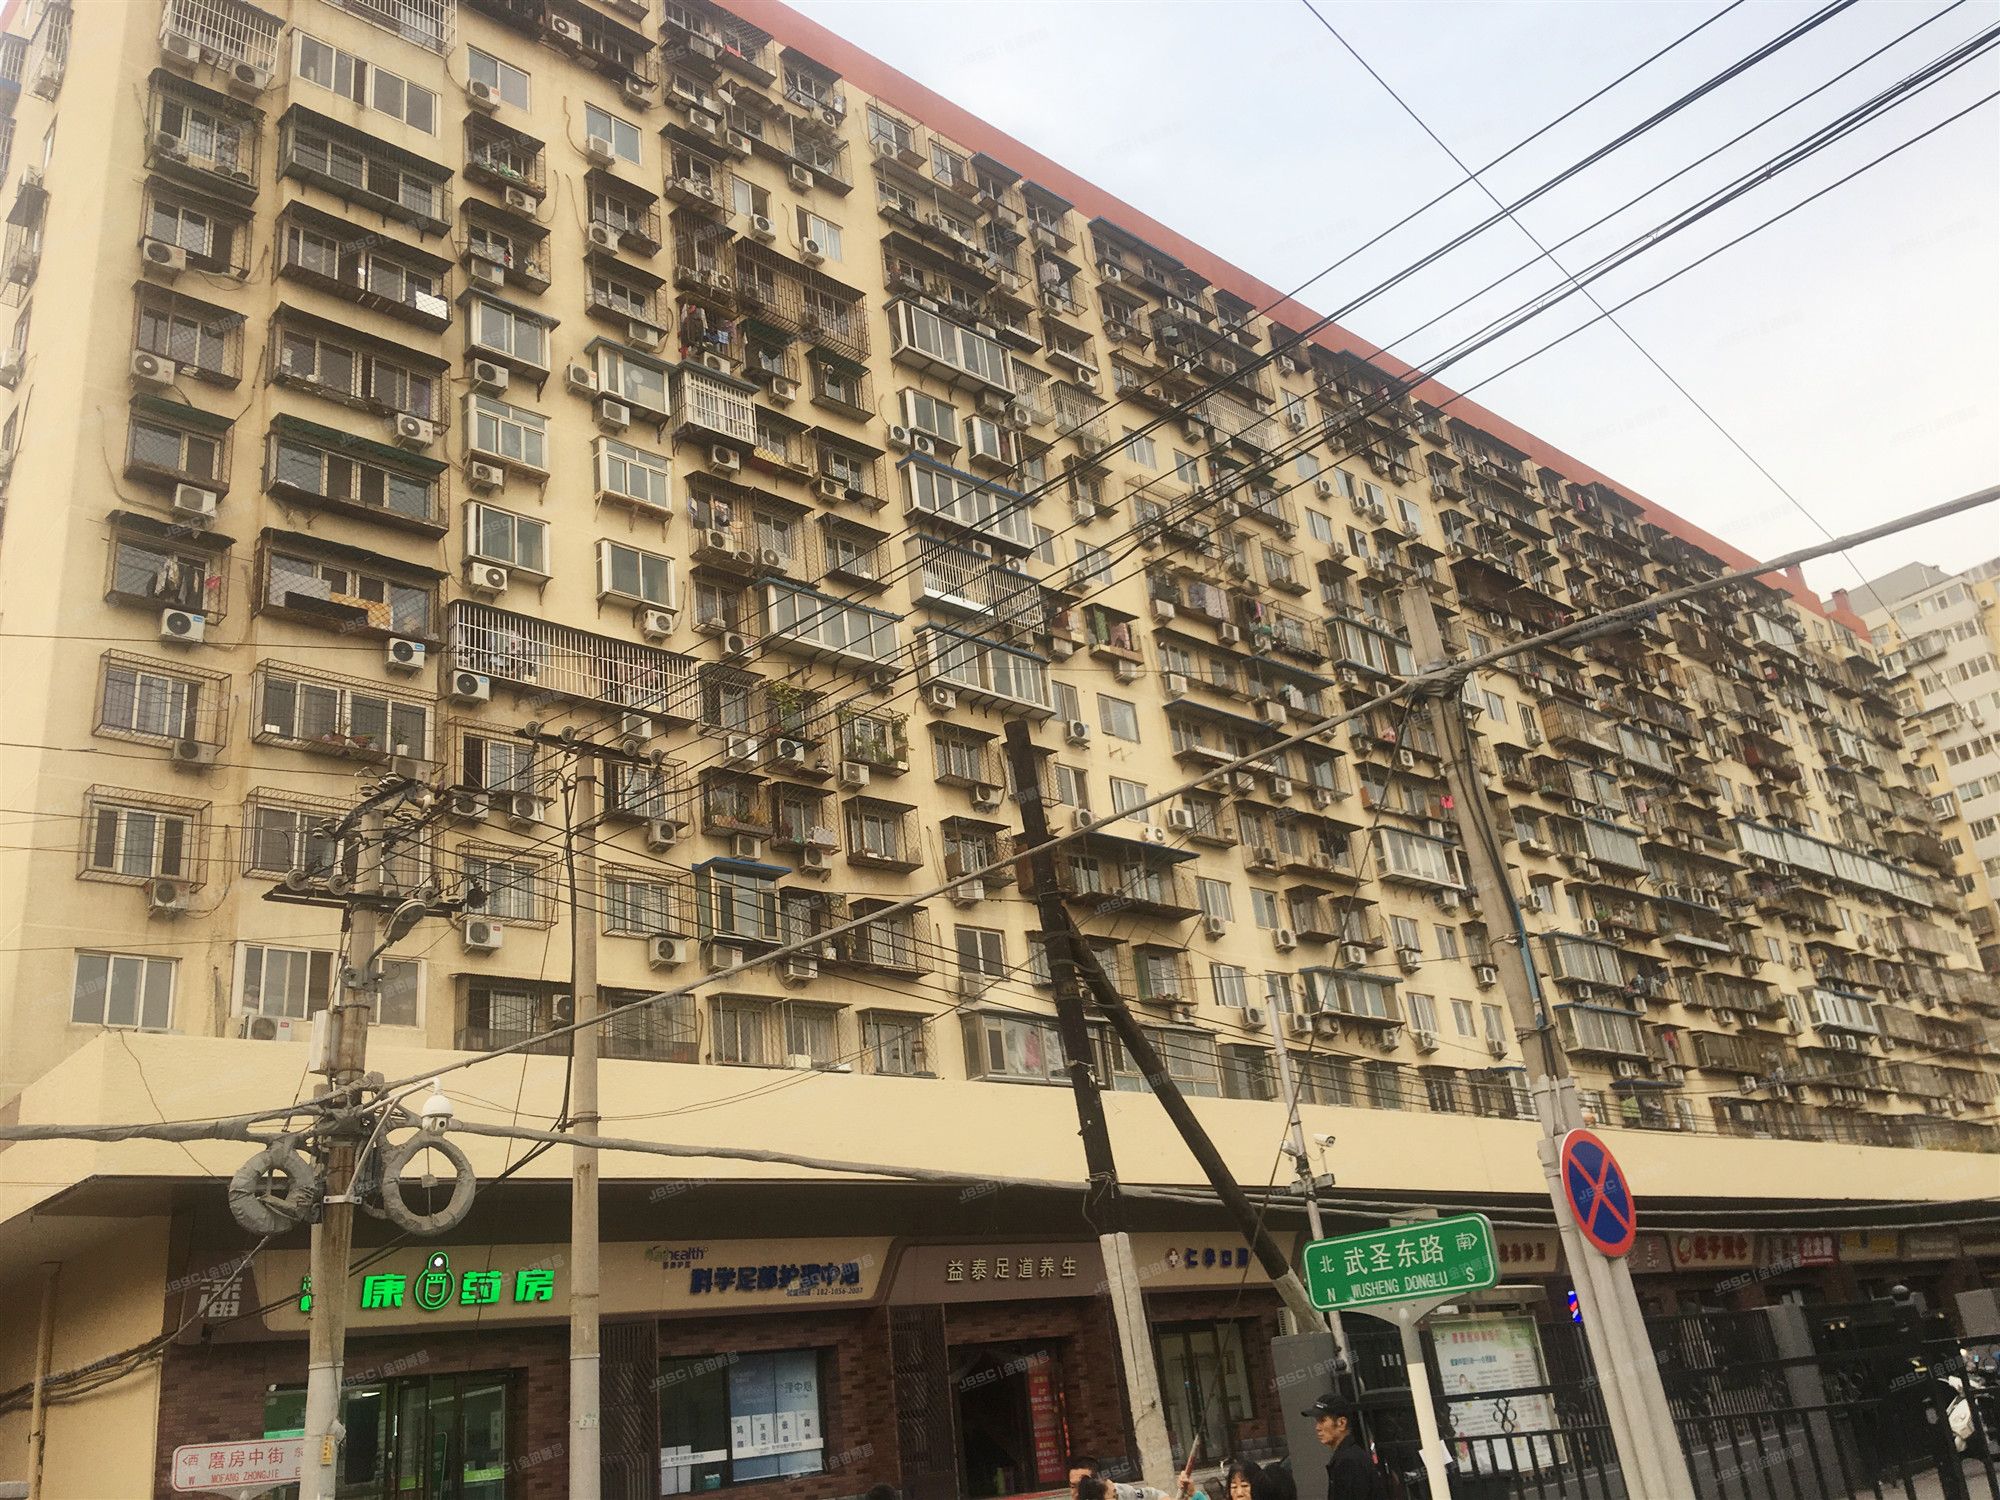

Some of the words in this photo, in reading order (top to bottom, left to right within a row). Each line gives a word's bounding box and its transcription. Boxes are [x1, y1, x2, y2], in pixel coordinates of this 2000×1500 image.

[1320, 1255, 1334, 1274] 北
[1344, 1234, 1444, 1276] 武圣东路
[1456, 1232, 1472, 1252] 南
[946, 1256, 1078, 1282] 益泰足道养生
[1328, 1288, 1336, 1302] N
[1351, 1279, 1399, 1299] WUSHENG
[1404, 1271, 1448, 1292] DONGLU
[1466, 1267, 1476, 1283] S
[188, 1454, 199, 1466] 西
[208, 1446, 284, 1470] 磨房中街
[188, 1476, 195, 1486] W
[211, 1472, 239, 1484] MOFANG
[243, 1469, 280, 1481] ZHONGJIE
